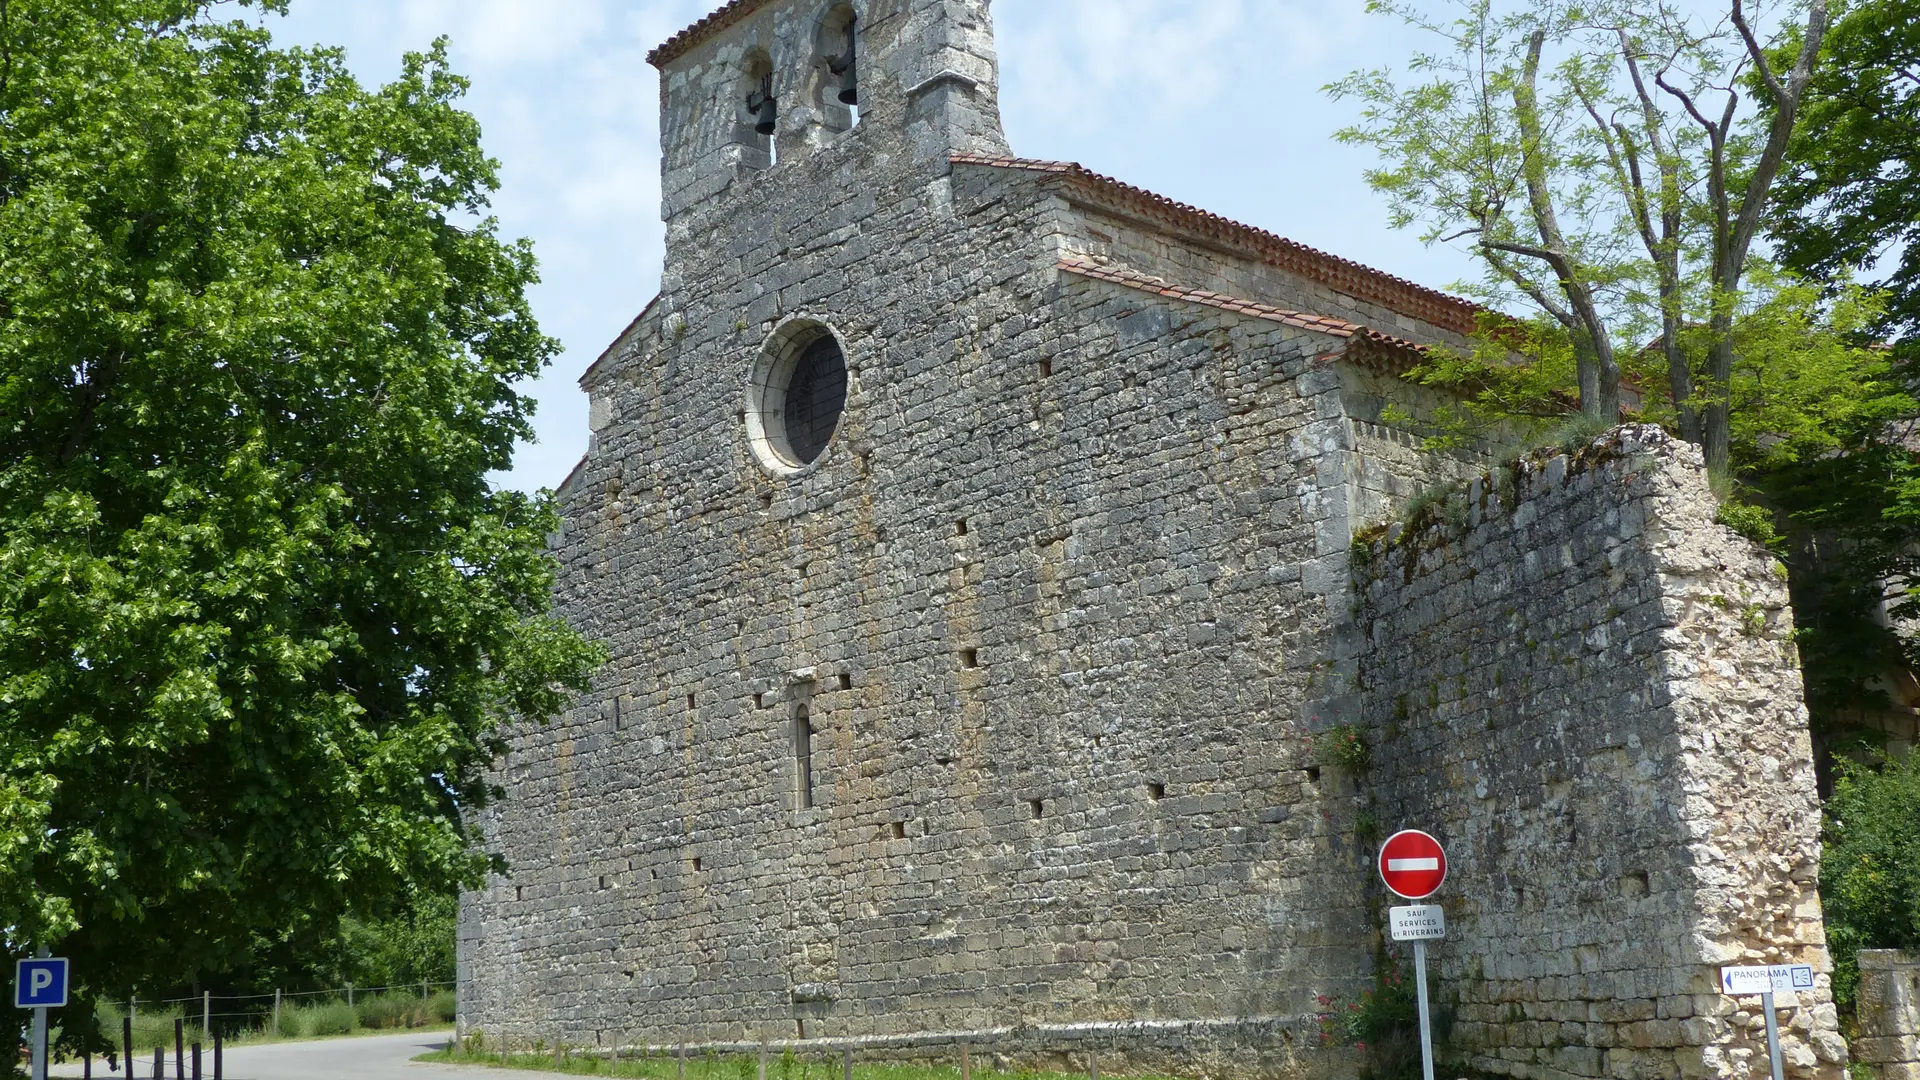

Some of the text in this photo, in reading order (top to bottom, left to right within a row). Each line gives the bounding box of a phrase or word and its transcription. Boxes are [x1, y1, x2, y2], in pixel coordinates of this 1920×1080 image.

[1398, 919, 1436, 927] SERVICES
[1402, 927, 1444, 936] RIVERAINS
[1733, 969, 1789, 979] PANORAMA
[30, 968, 53, 998] P
